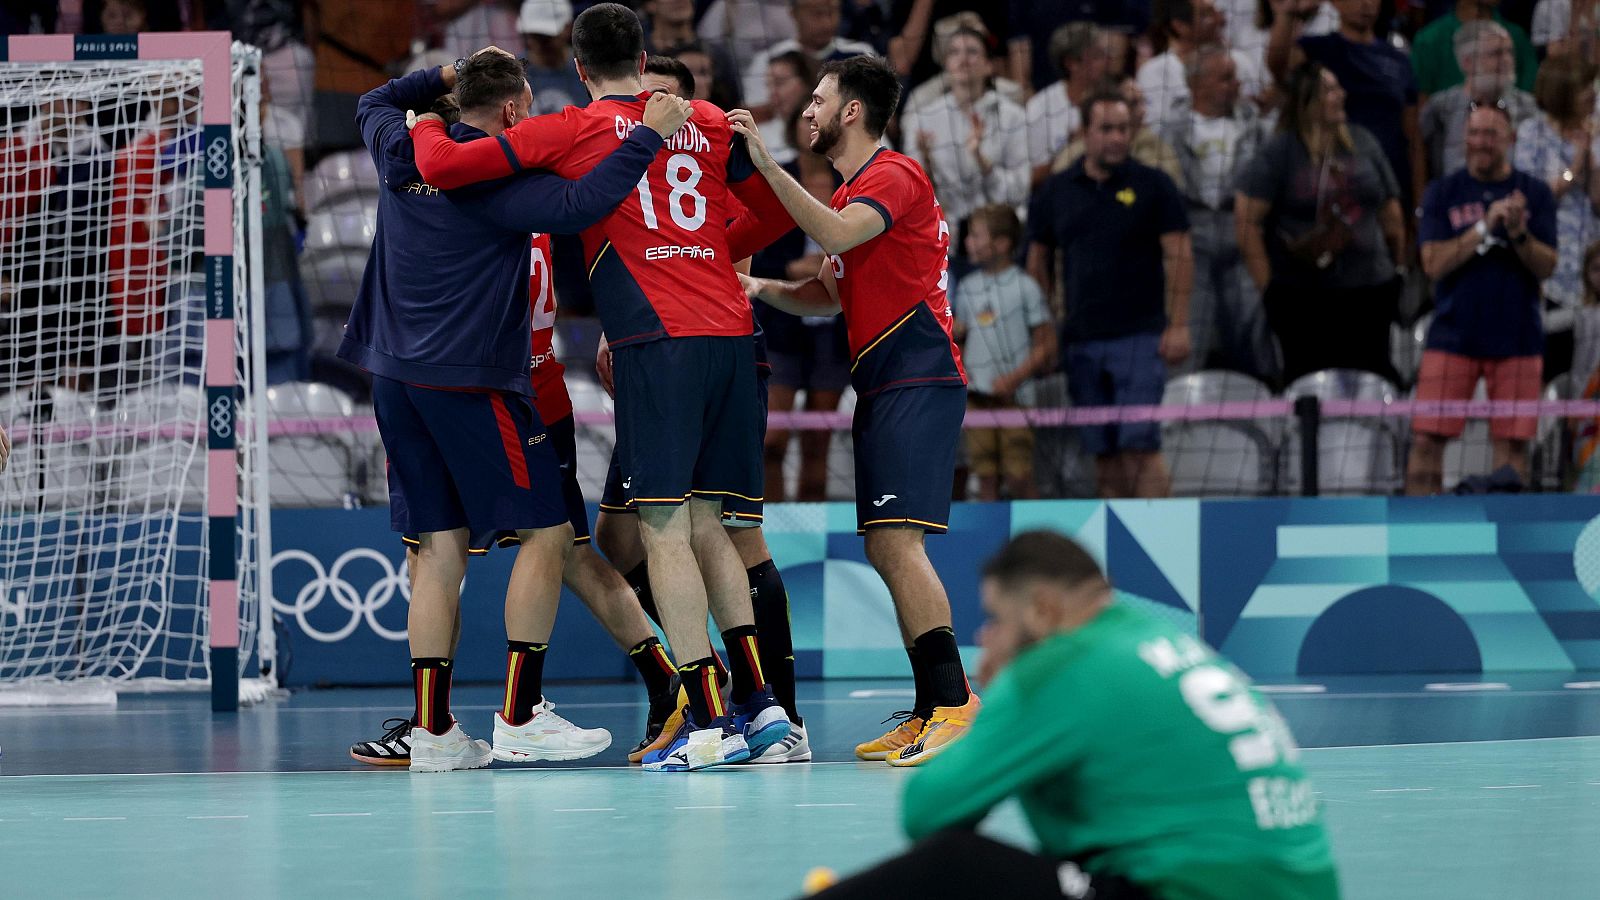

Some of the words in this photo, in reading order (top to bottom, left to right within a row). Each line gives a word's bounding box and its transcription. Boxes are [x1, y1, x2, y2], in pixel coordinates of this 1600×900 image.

[76, 42, 106, 52] PARIS
[109, 42, 137, 52] 2024
[637, 153, 706, 231] 18
[645, 245, 715, 260] ESPAÑA
[528, 433, 546, 446] ESP
